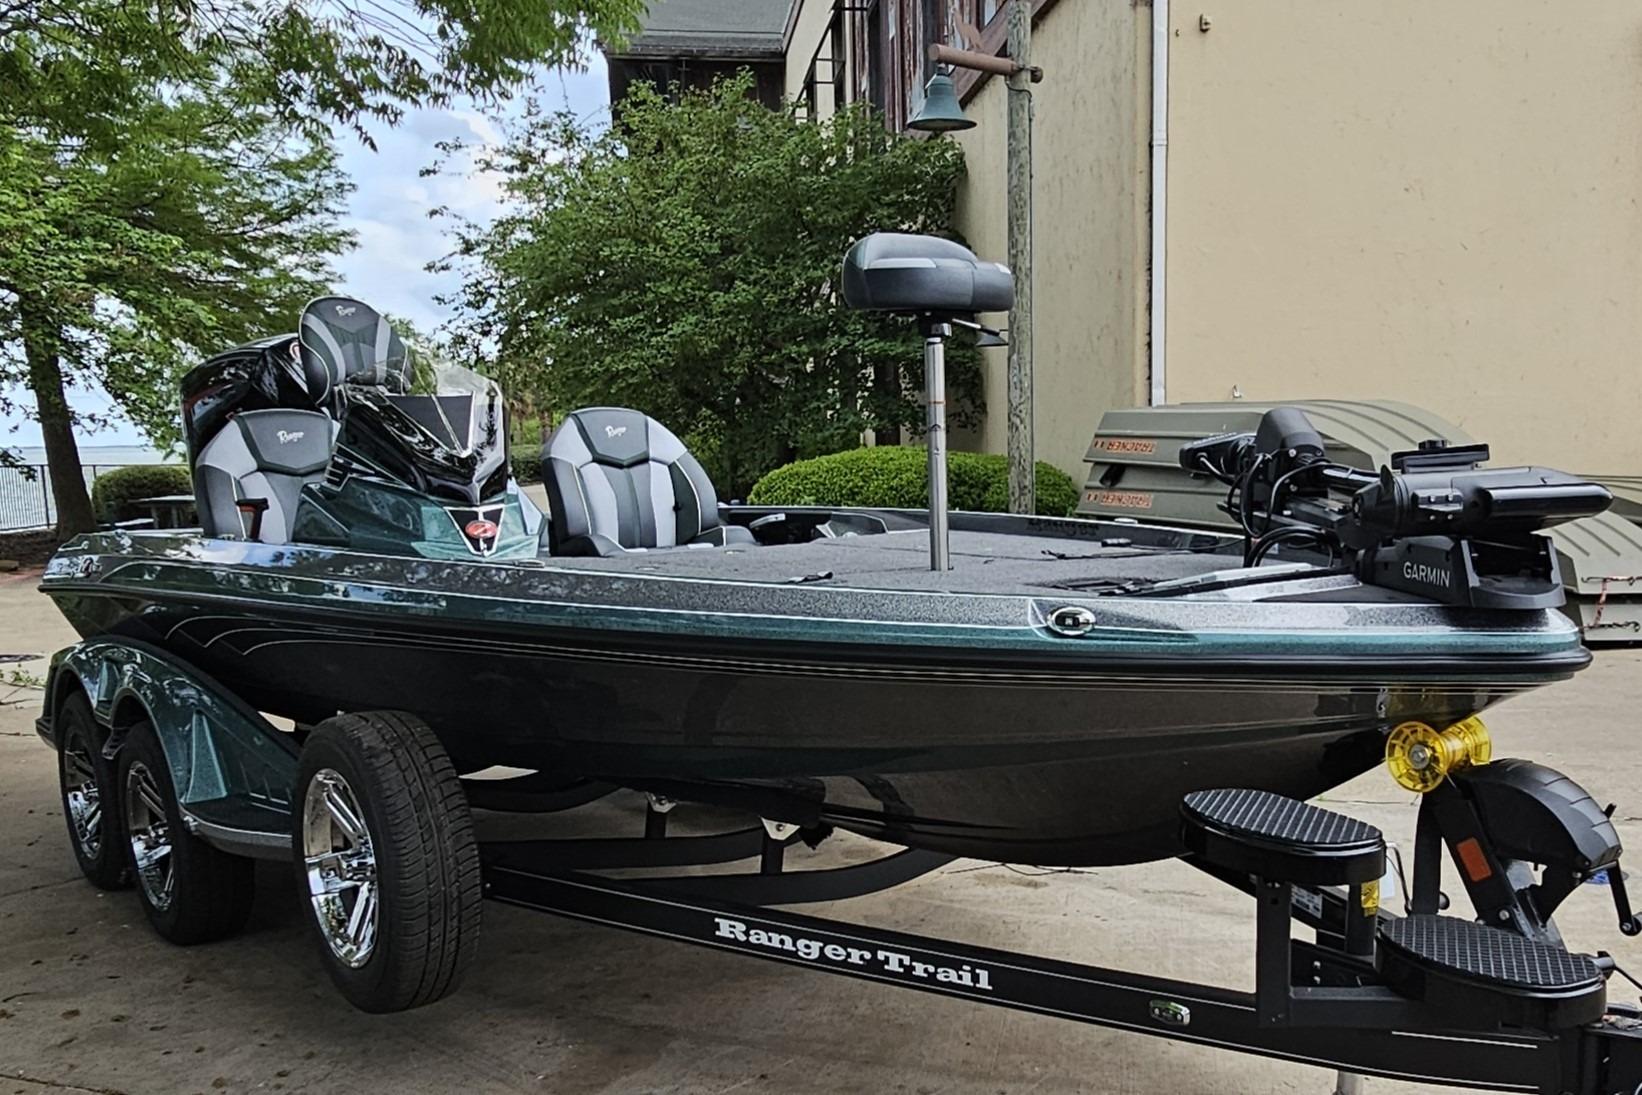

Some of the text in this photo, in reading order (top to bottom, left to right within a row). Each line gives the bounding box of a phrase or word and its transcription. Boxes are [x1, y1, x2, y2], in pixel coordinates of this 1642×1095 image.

[1403, 561, 1450, 588] GARMIN
[714, 917, 993, 990] Ranger Trail
